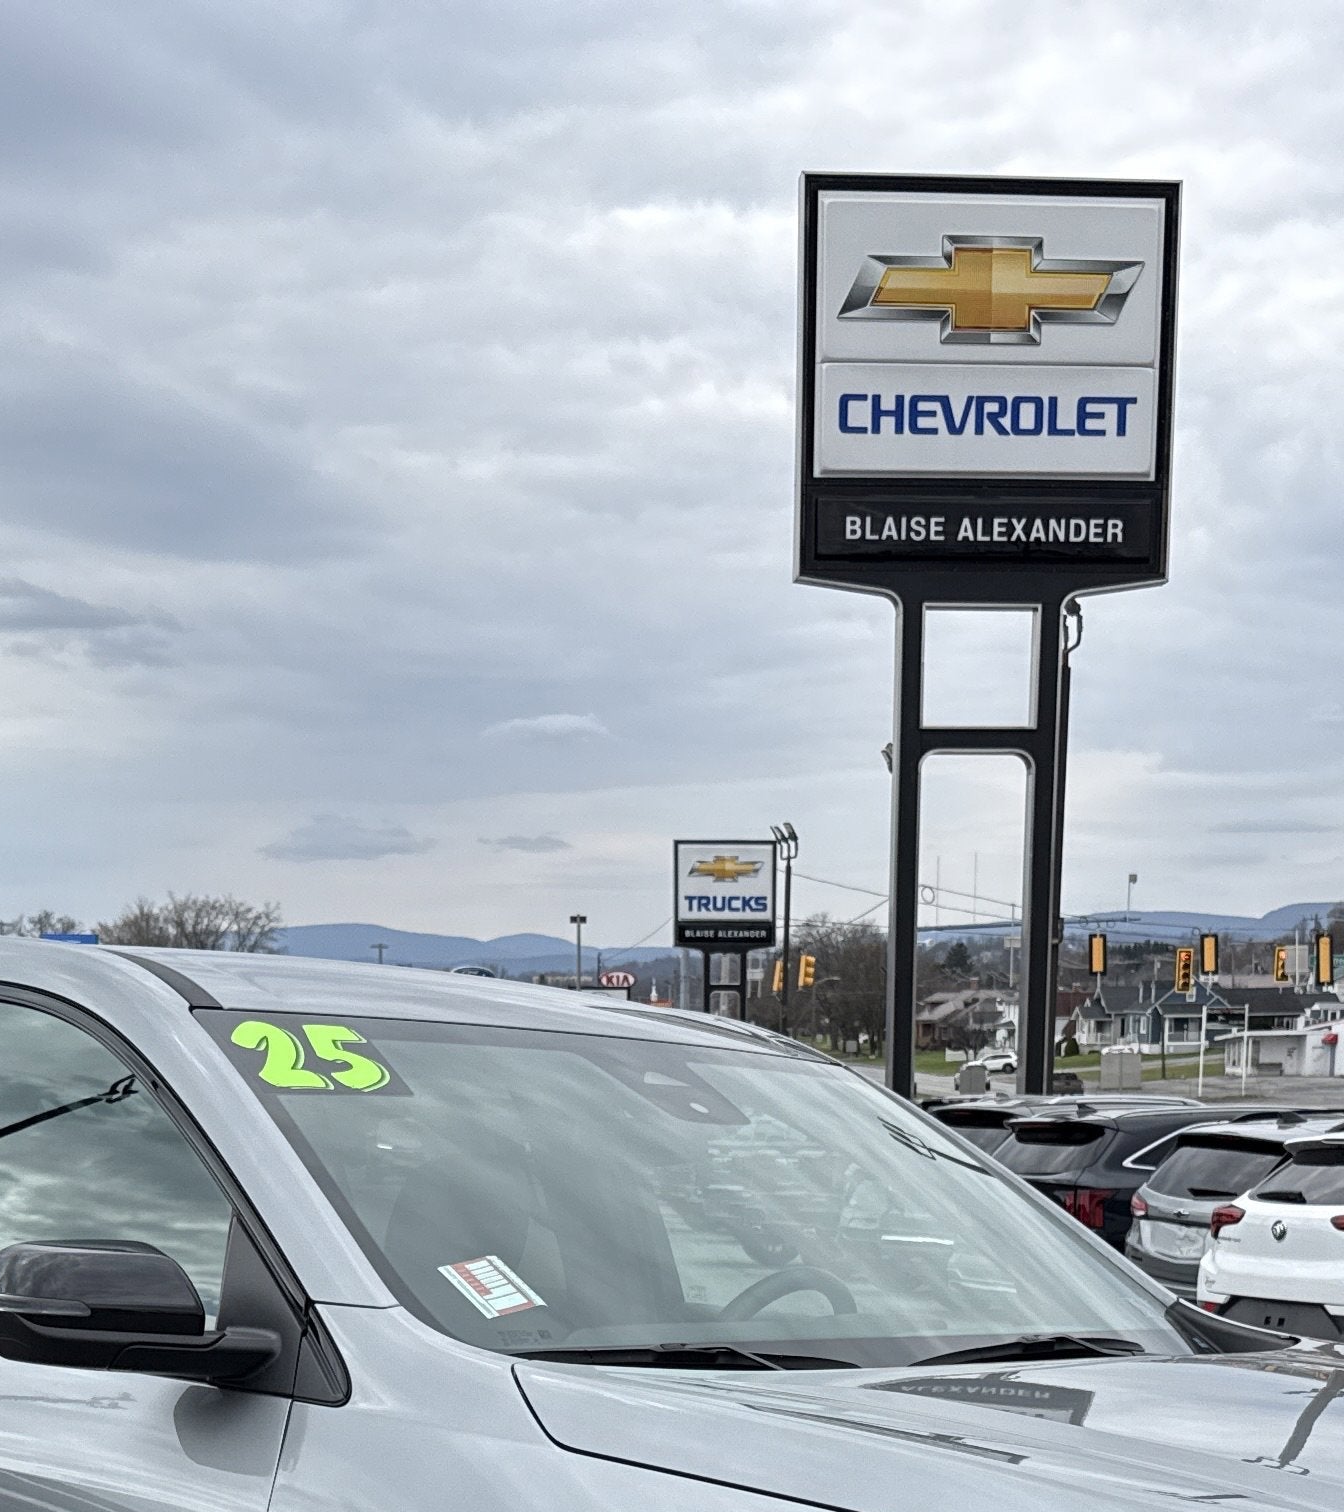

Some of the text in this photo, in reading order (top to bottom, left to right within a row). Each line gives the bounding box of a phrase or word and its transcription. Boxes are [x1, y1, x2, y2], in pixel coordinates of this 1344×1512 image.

[838, 393, 1138, 437] CHEVROLET
[845, 516, 1124, 543] BLAISE ALEXANDER
[684, 895, 768, 912] TRUCKS
[684, 930, 767, 939] BLAISE ALEXANDER
[605, 975, 631, 986] KIA
[230, 1020, 391, 1092] 25
